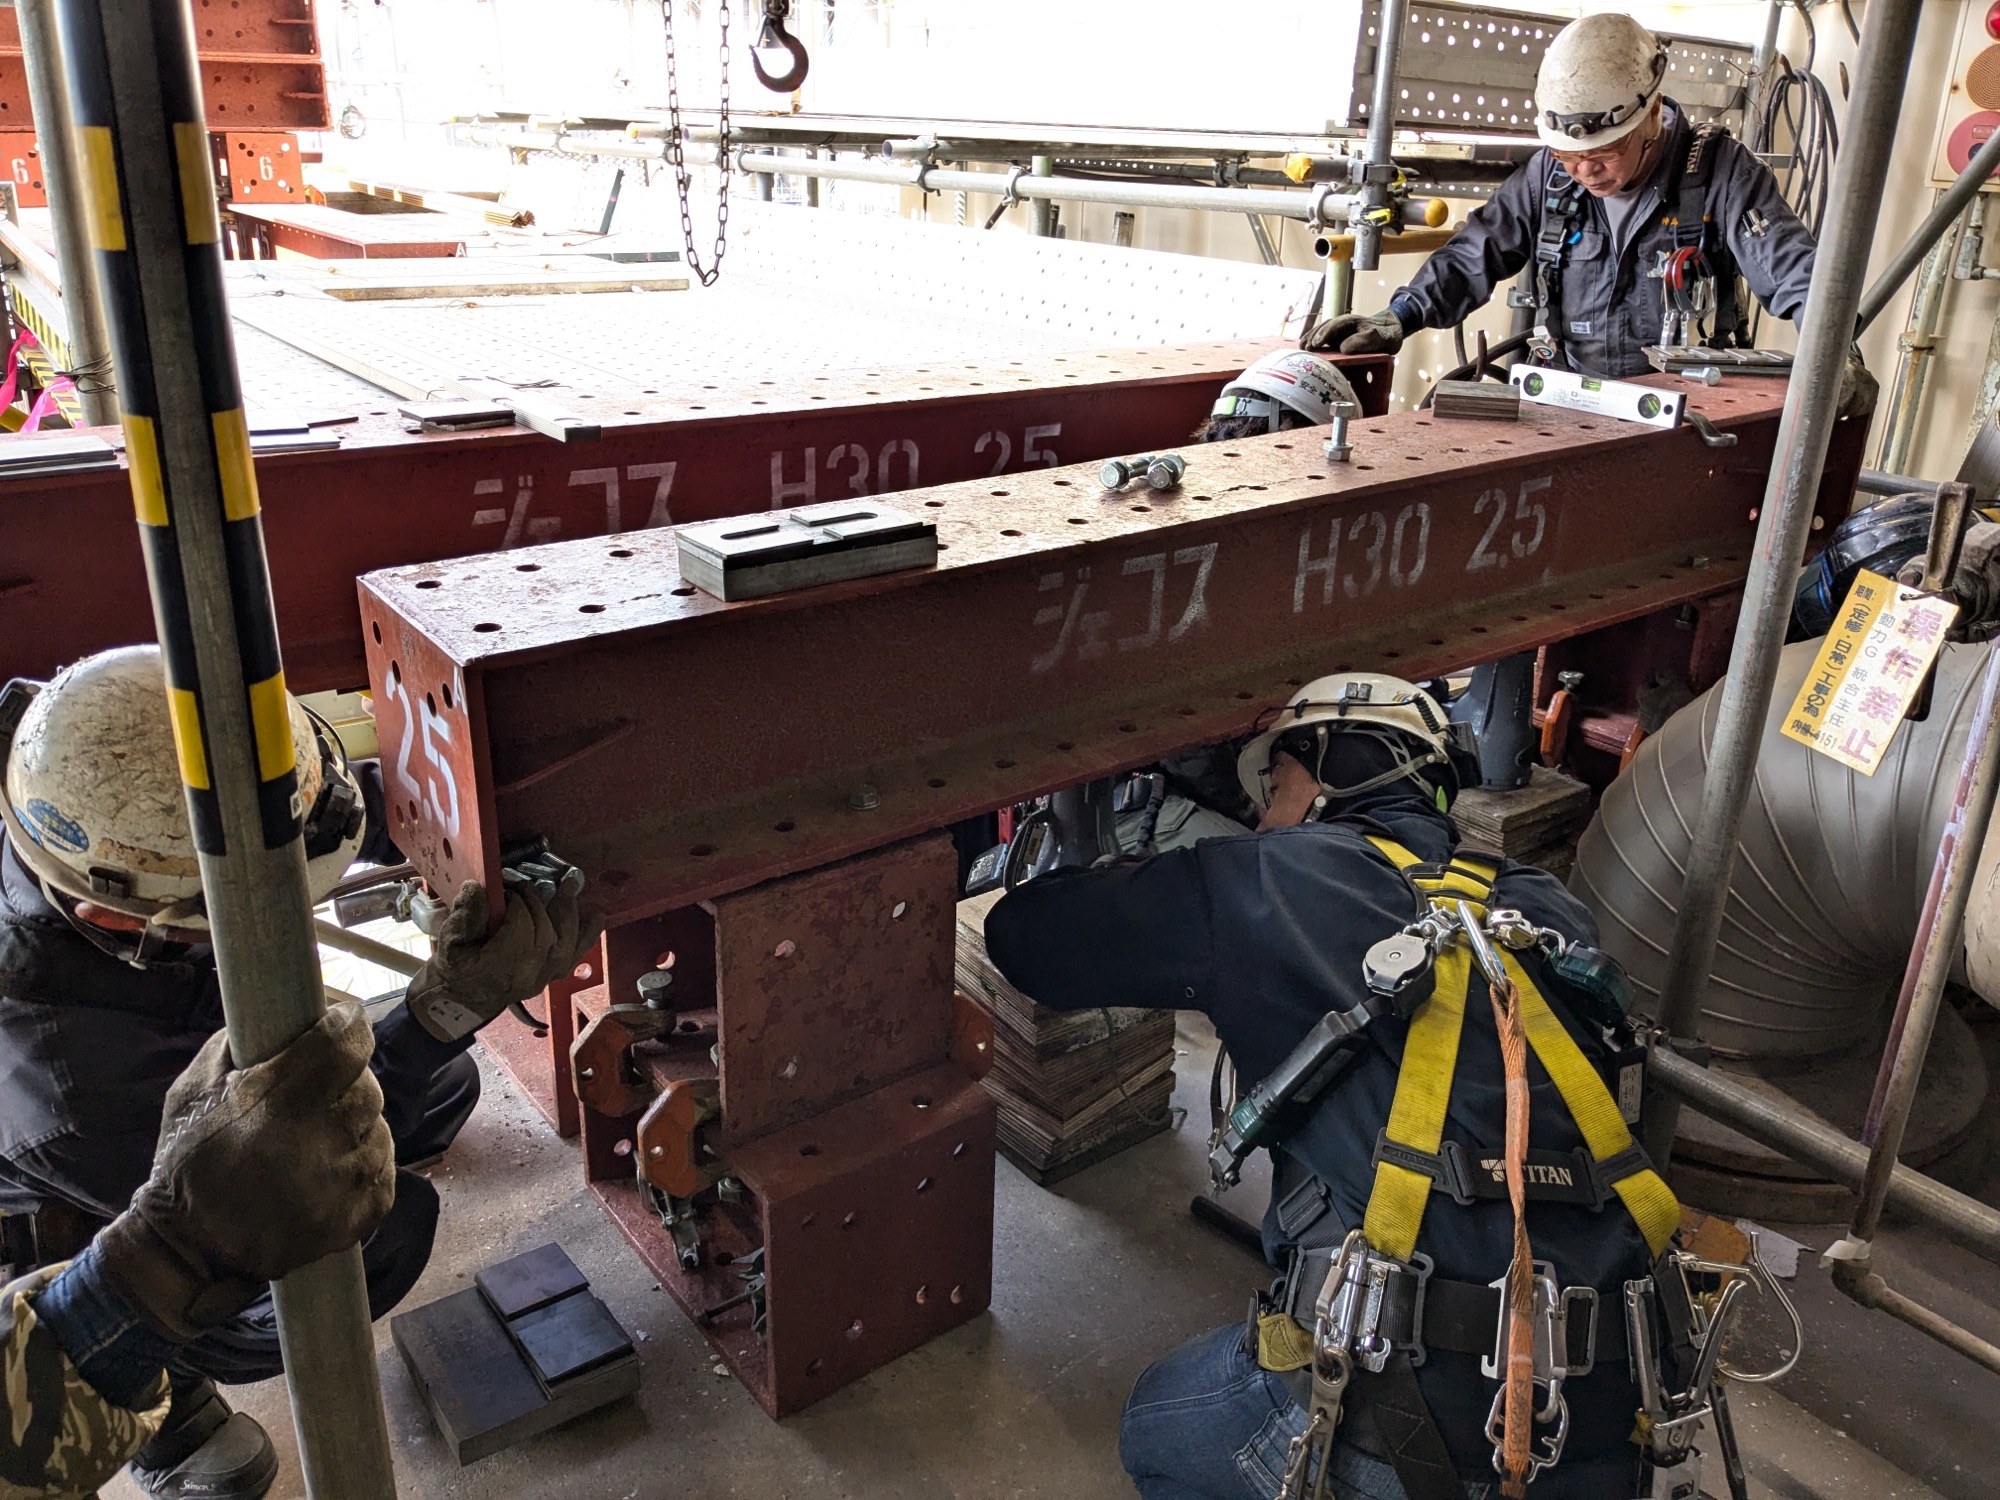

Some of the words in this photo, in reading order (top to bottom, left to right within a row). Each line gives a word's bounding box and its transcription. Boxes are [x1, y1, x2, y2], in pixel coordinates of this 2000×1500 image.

[12, 158, 28, 184] 6
[259, 155, 273, 181] 6
[1686, 139, 1702, 173] TITAN
[771, 438, 919, 510] H30
[1293, 503, 1431, 613] H30
[1838, 604, 1943, 764] 操作禁止
[1521, 1165, 1573, 1187] ITAN
[179, 1479, 214, 1491] Simon
